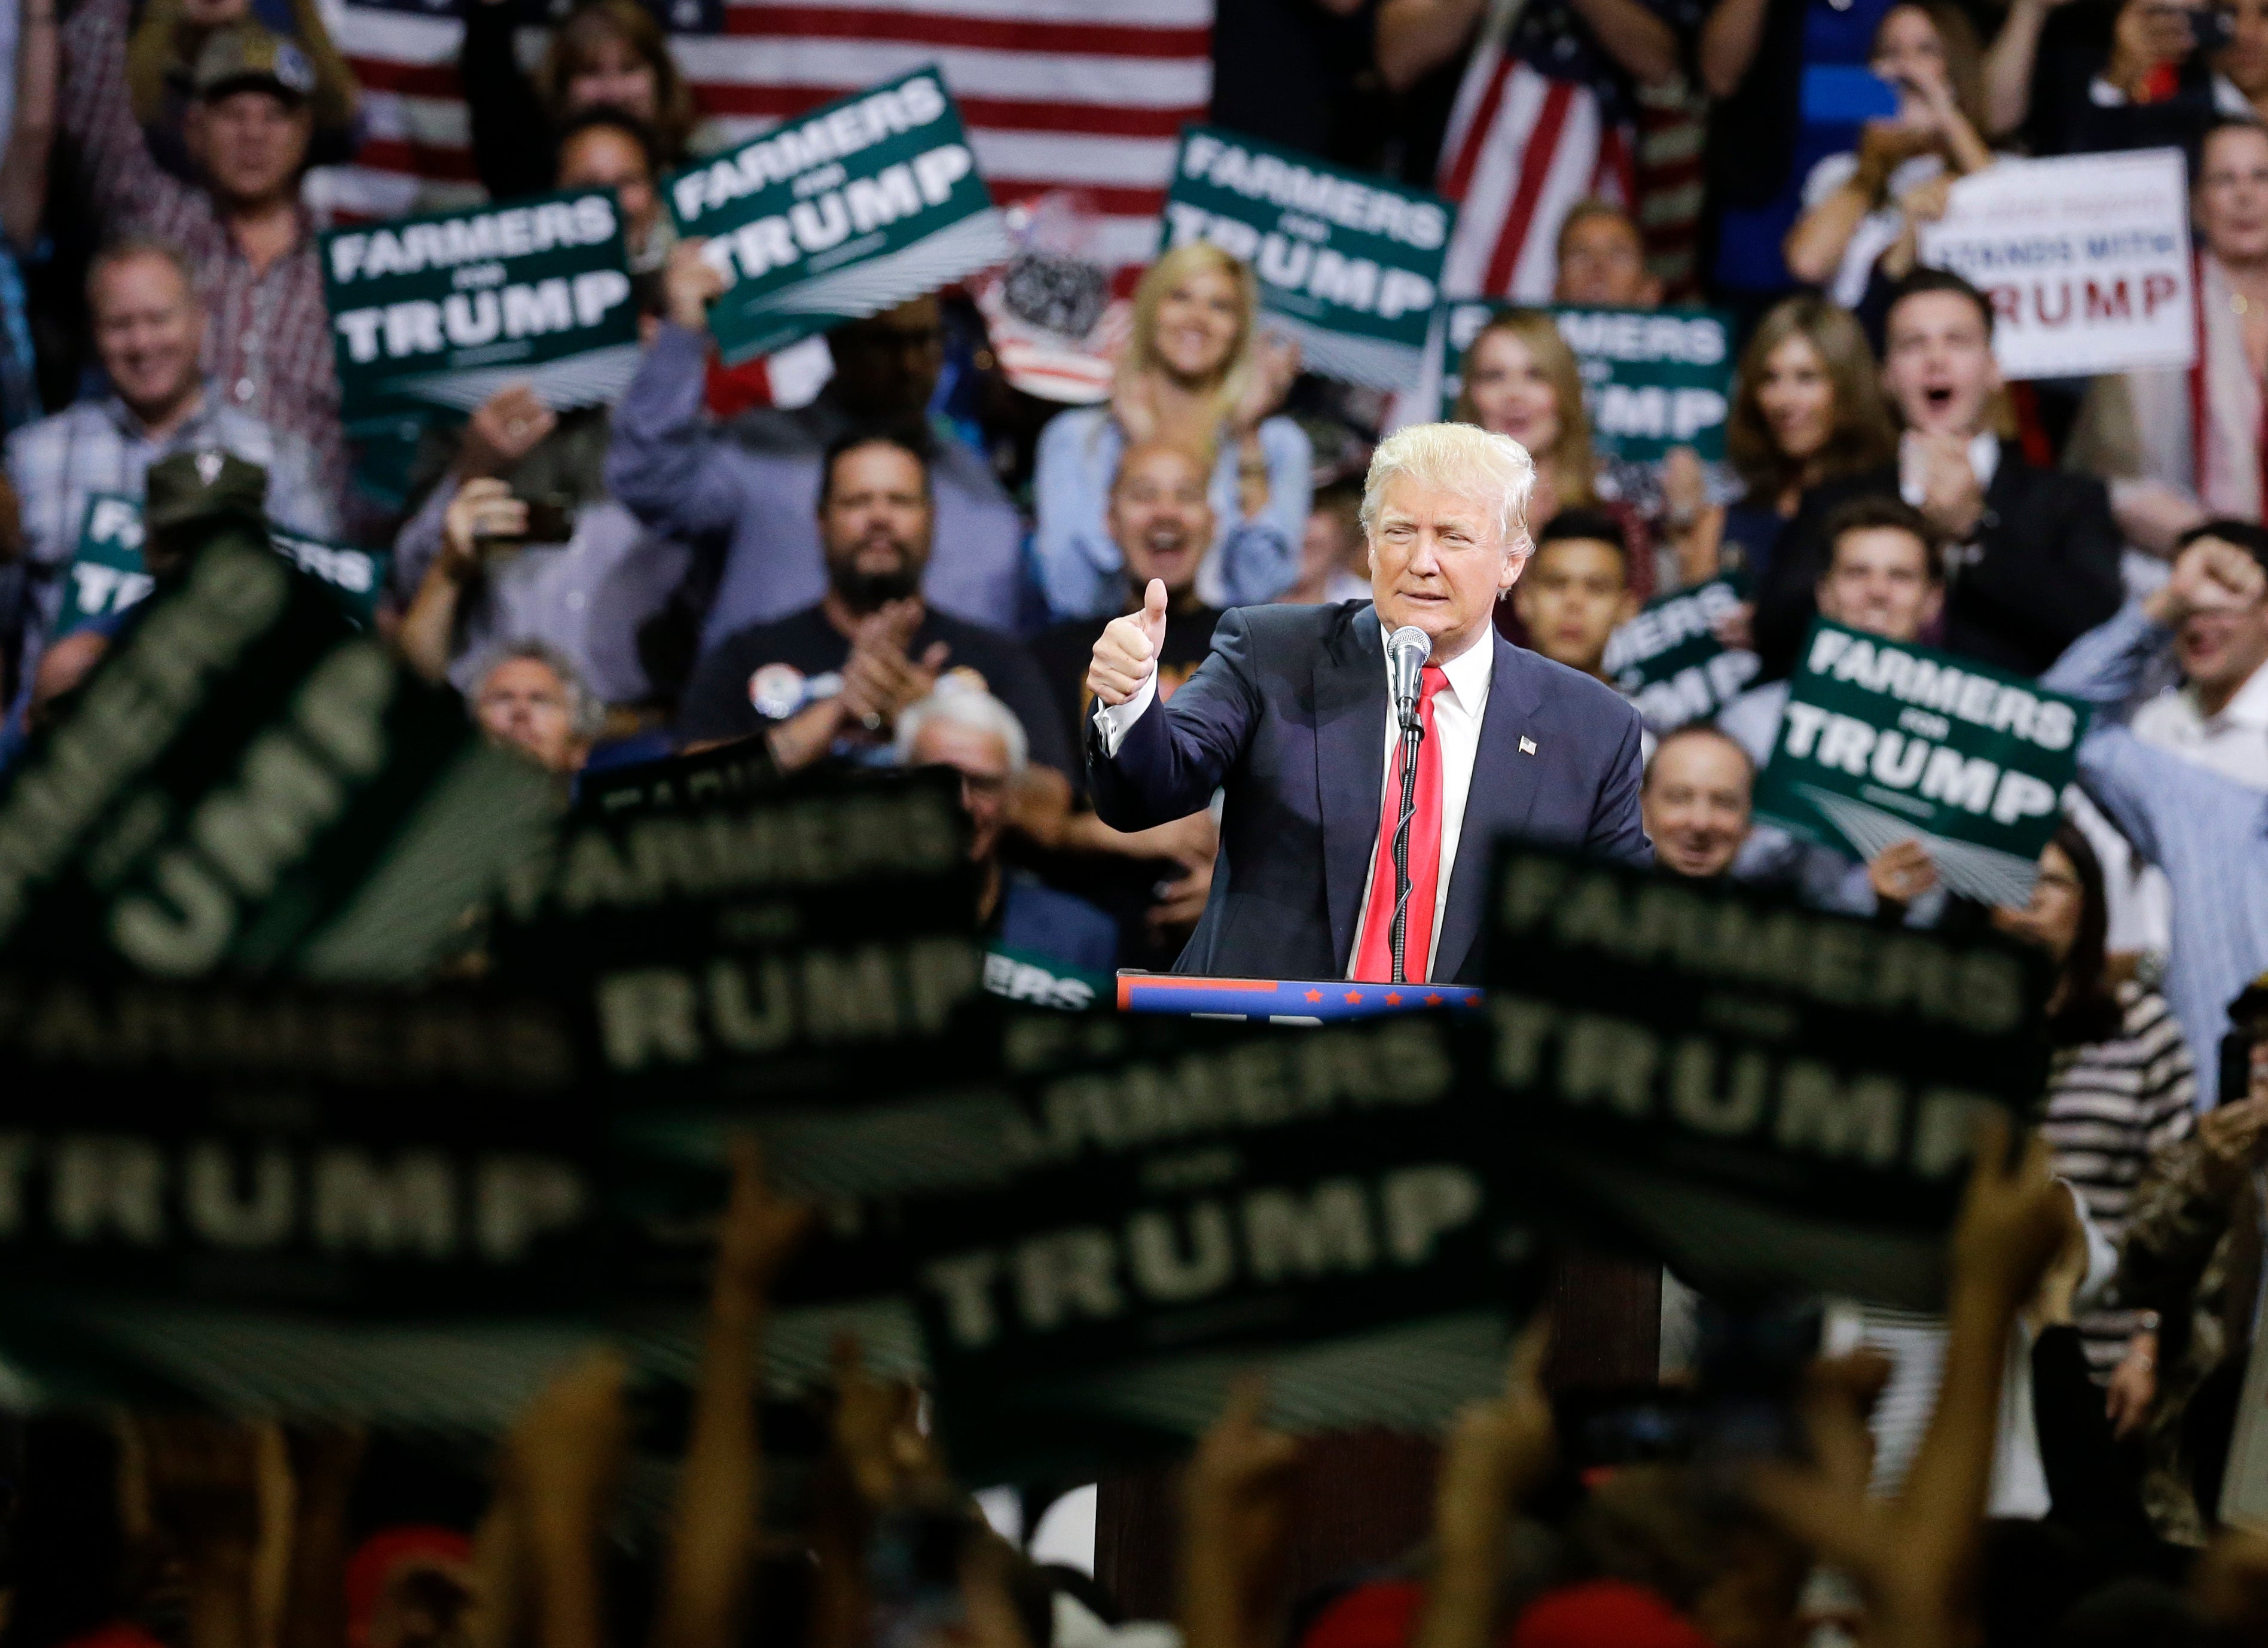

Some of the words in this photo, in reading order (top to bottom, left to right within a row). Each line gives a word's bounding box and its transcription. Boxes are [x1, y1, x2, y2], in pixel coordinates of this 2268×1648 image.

[670, 74, 948, 222] FARMERS
[1183, 132, 1449, 251] FARMERS
[329, 194, 618, 284] FARMERS
[701, 142, 973, 288] TRUMP
[335, 269, 633, 363] TRUMP
[1988, 271, 2179, 328] RUMP
[1807, 627, 2078, 752] FARMERS
[1783, 699, 2057, 826] TRUMP
[593, 929, 981, 1073] RUMP
[1498, 852, 2028, 1039] FARMERS
[918, 1159, 1489, 1355] TRUMP
